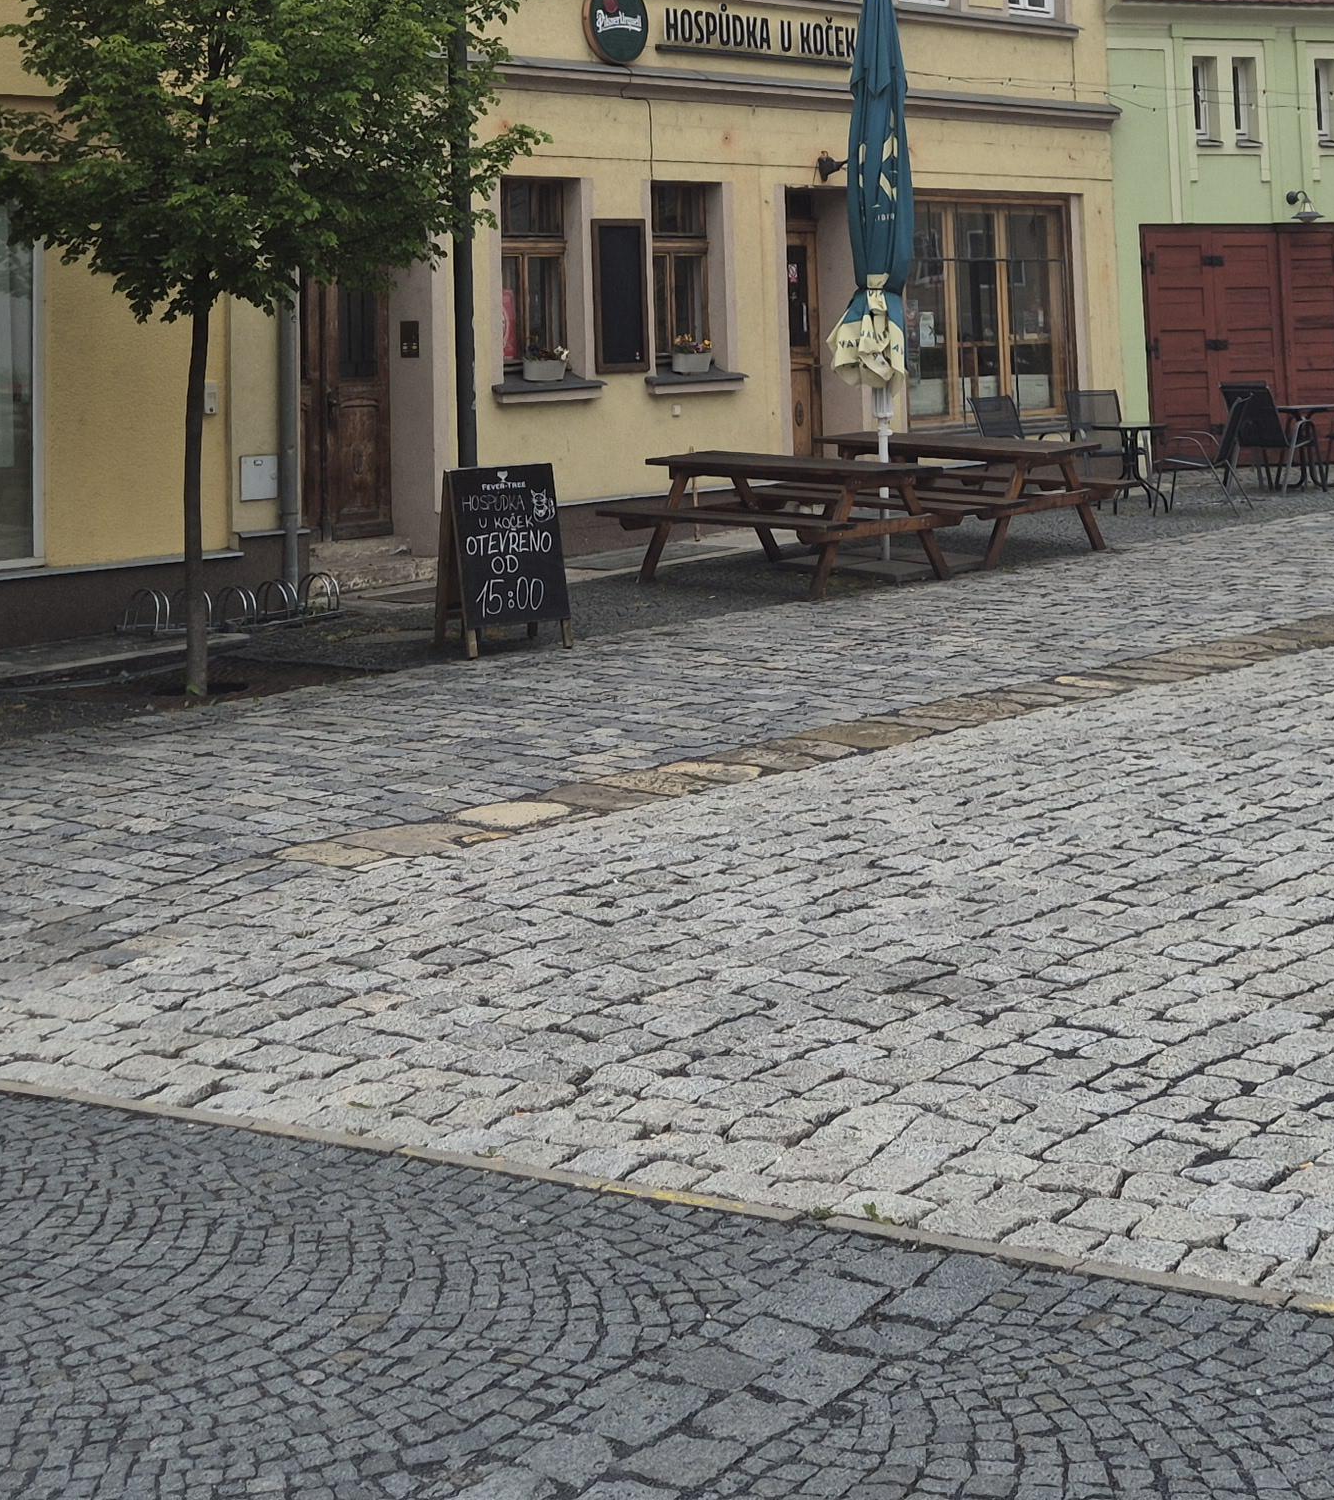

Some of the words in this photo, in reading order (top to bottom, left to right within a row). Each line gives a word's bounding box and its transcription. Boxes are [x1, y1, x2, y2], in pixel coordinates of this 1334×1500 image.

[665, 3, 771, 50] HOSPŮDKA
[780, 20, 792, 52] U
[800, 16, 857, 58] KOČEK
[481, 481, 526, 491] FEVER-TREE
[478, 518, 488, 529] U
[494, 513, 535, 530] KOČEK
[465, 528, 552, 557] OTEVŘENO
[491, 555, 519, 576] OD
[475, 576, 545, 618] 15:00
